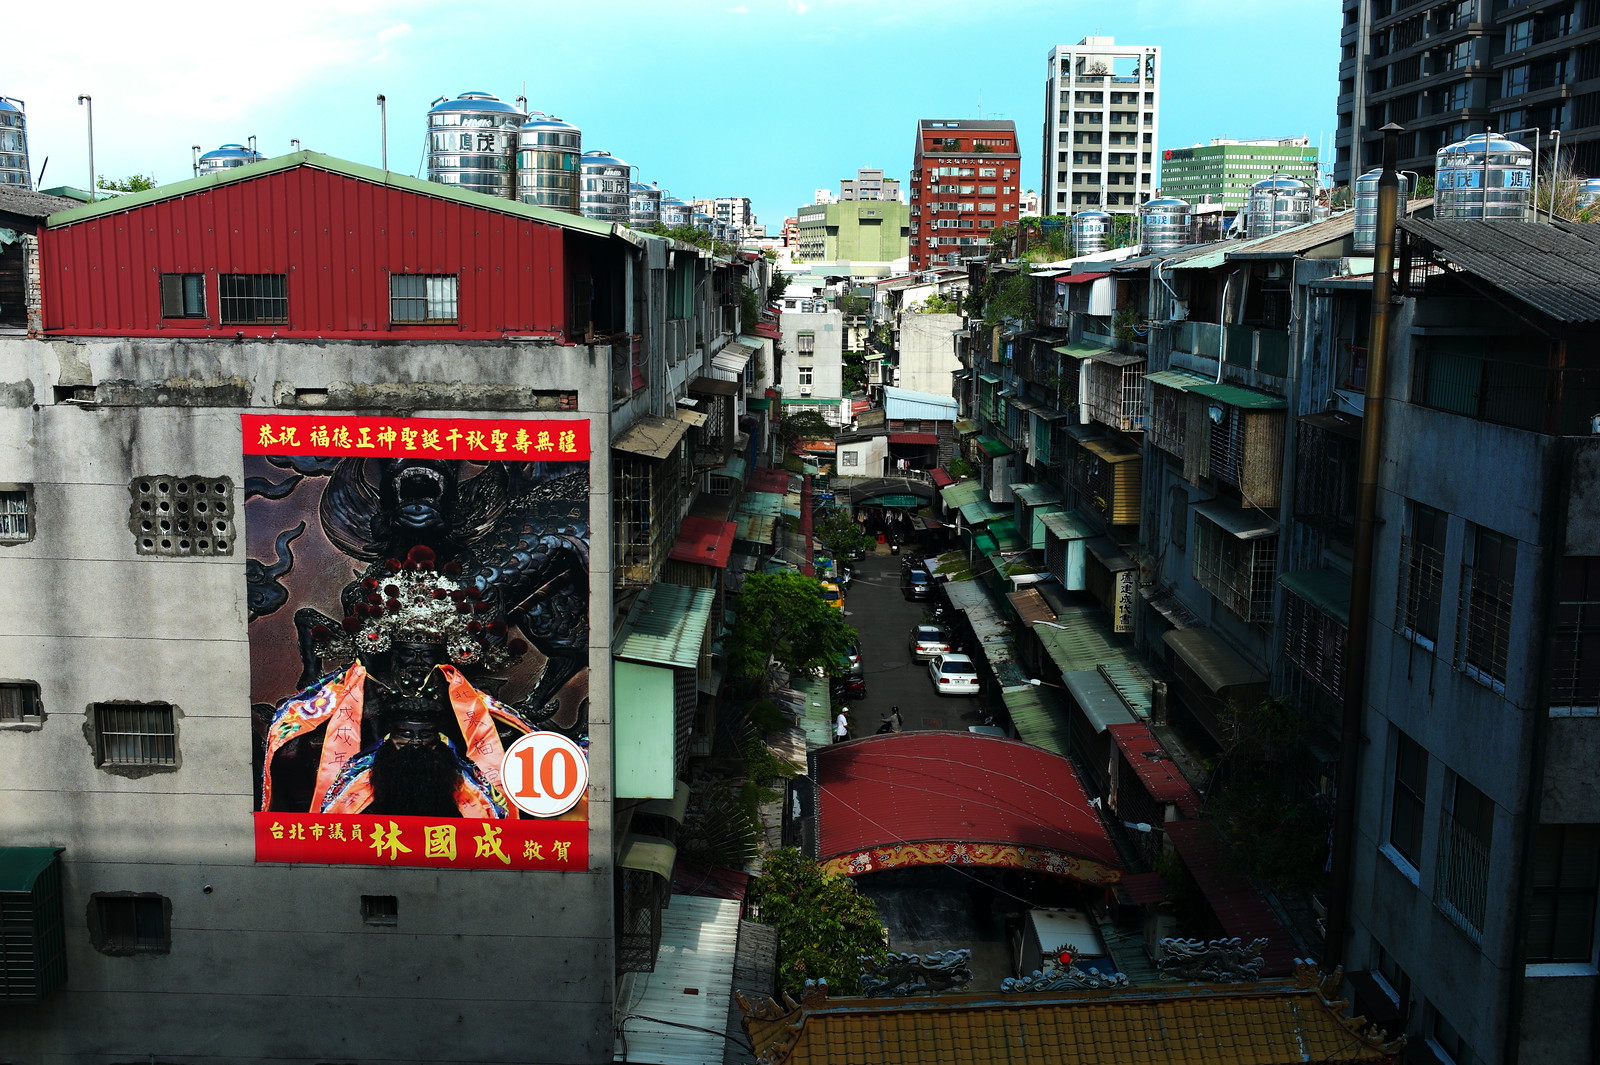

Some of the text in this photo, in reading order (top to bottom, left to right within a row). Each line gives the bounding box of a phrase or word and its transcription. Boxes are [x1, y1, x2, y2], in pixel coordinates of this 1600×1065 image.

[514, 746, 578, 800] 10
[269, 820, 572, 865] 台北市議員 林國成 敬賀
